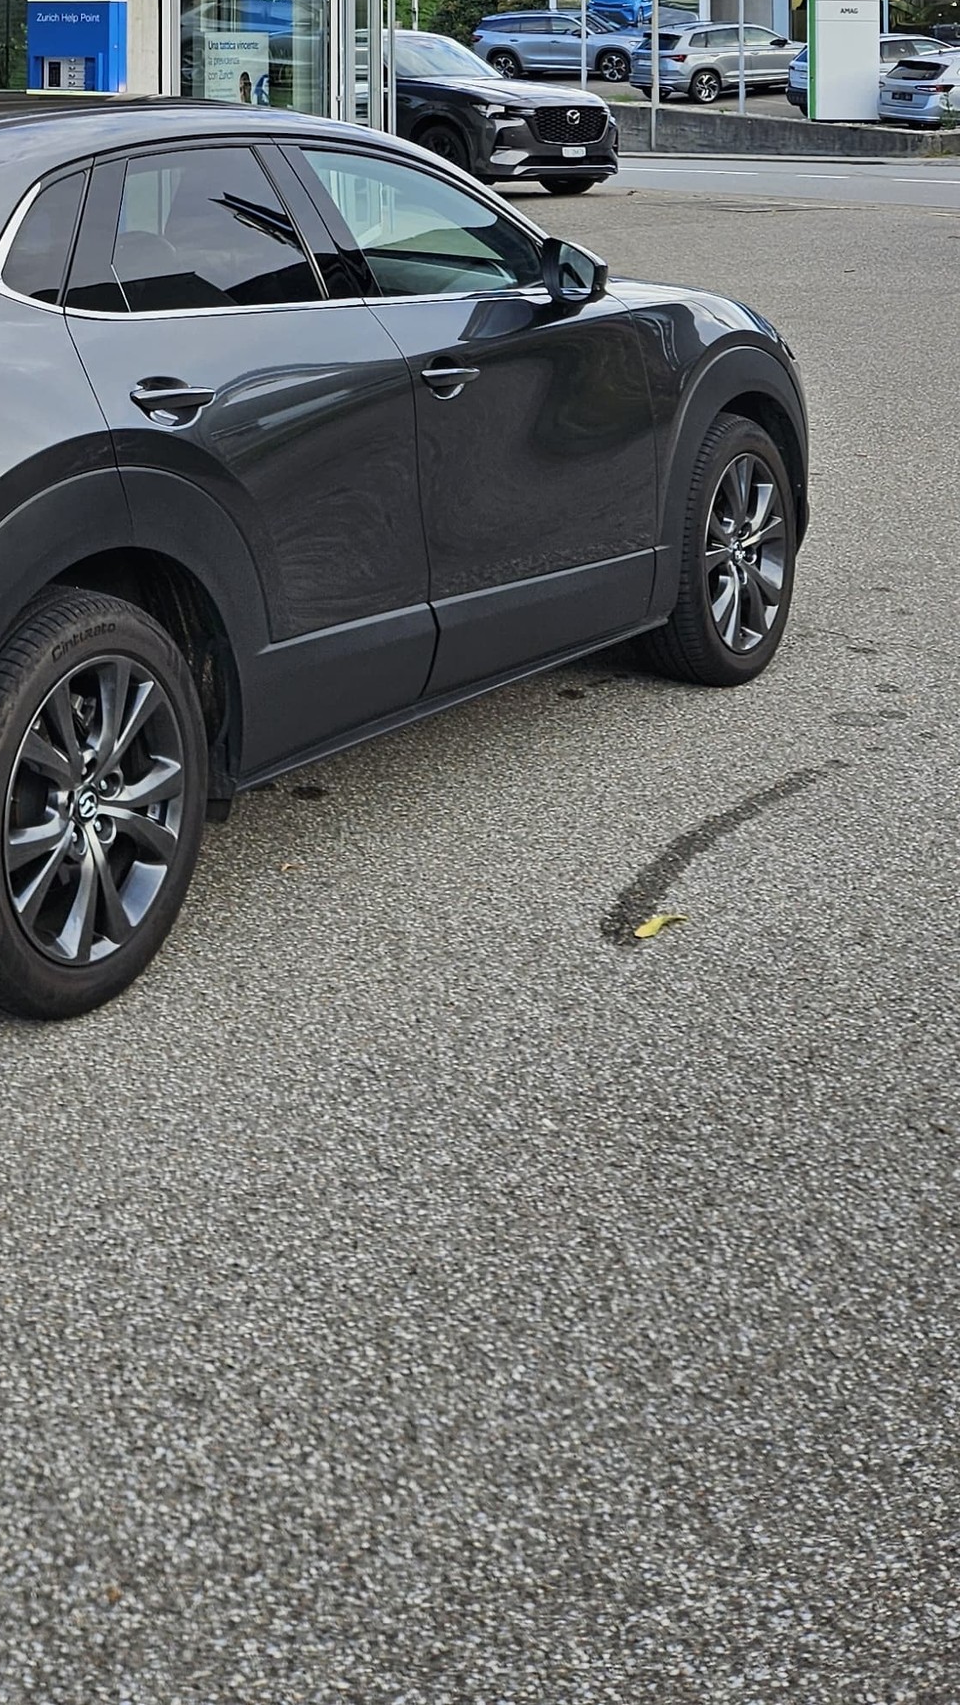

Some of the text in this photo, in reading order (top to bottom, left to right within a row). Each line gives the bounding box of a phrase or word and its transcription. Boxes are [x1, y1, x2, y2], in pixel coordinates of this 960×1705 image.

[36, 13, 100, 23] Zurich Help Point
